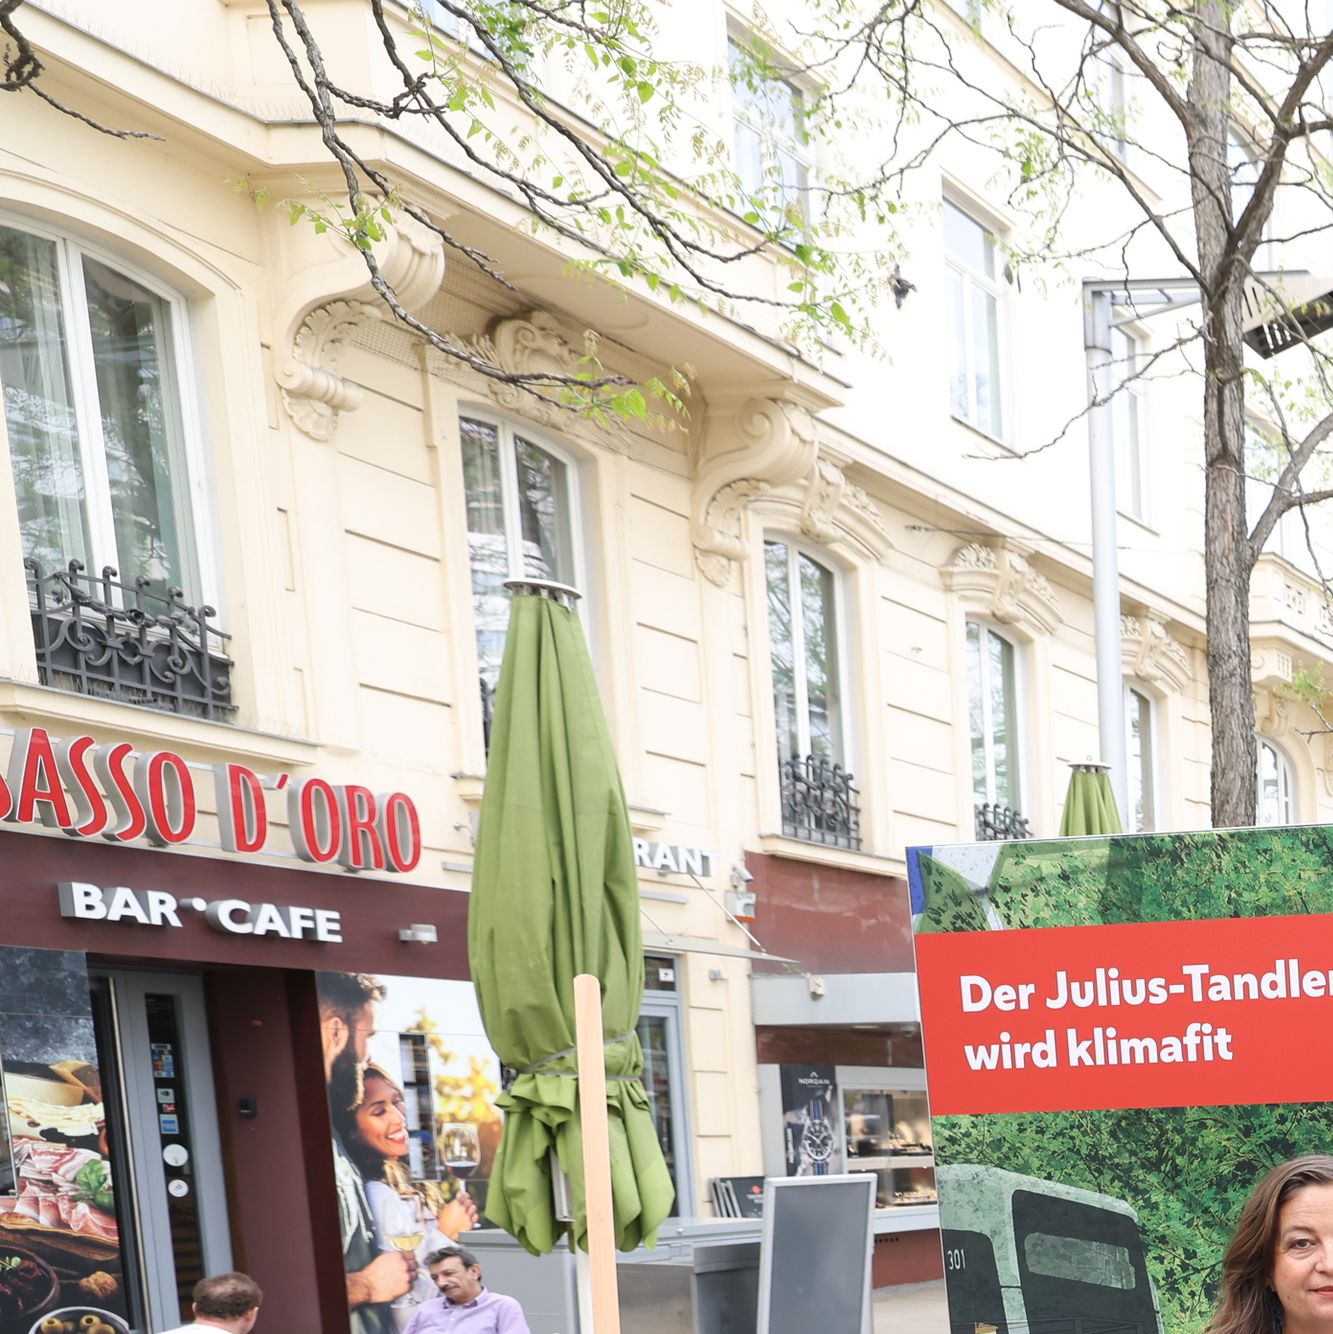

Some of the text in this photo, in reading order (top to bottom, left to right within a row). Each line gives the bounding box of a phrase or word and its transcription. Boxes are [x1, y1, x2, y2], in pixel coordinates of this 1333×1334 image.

[0, 727, 196, 846] ASSO
[70, 882, 344, 943] BAR CAFE
[959, 973, 1035, 1012] Der
[964, 1022, 1233, 1071] wird klimafit
[947, 1248, 966, 1270] 301
